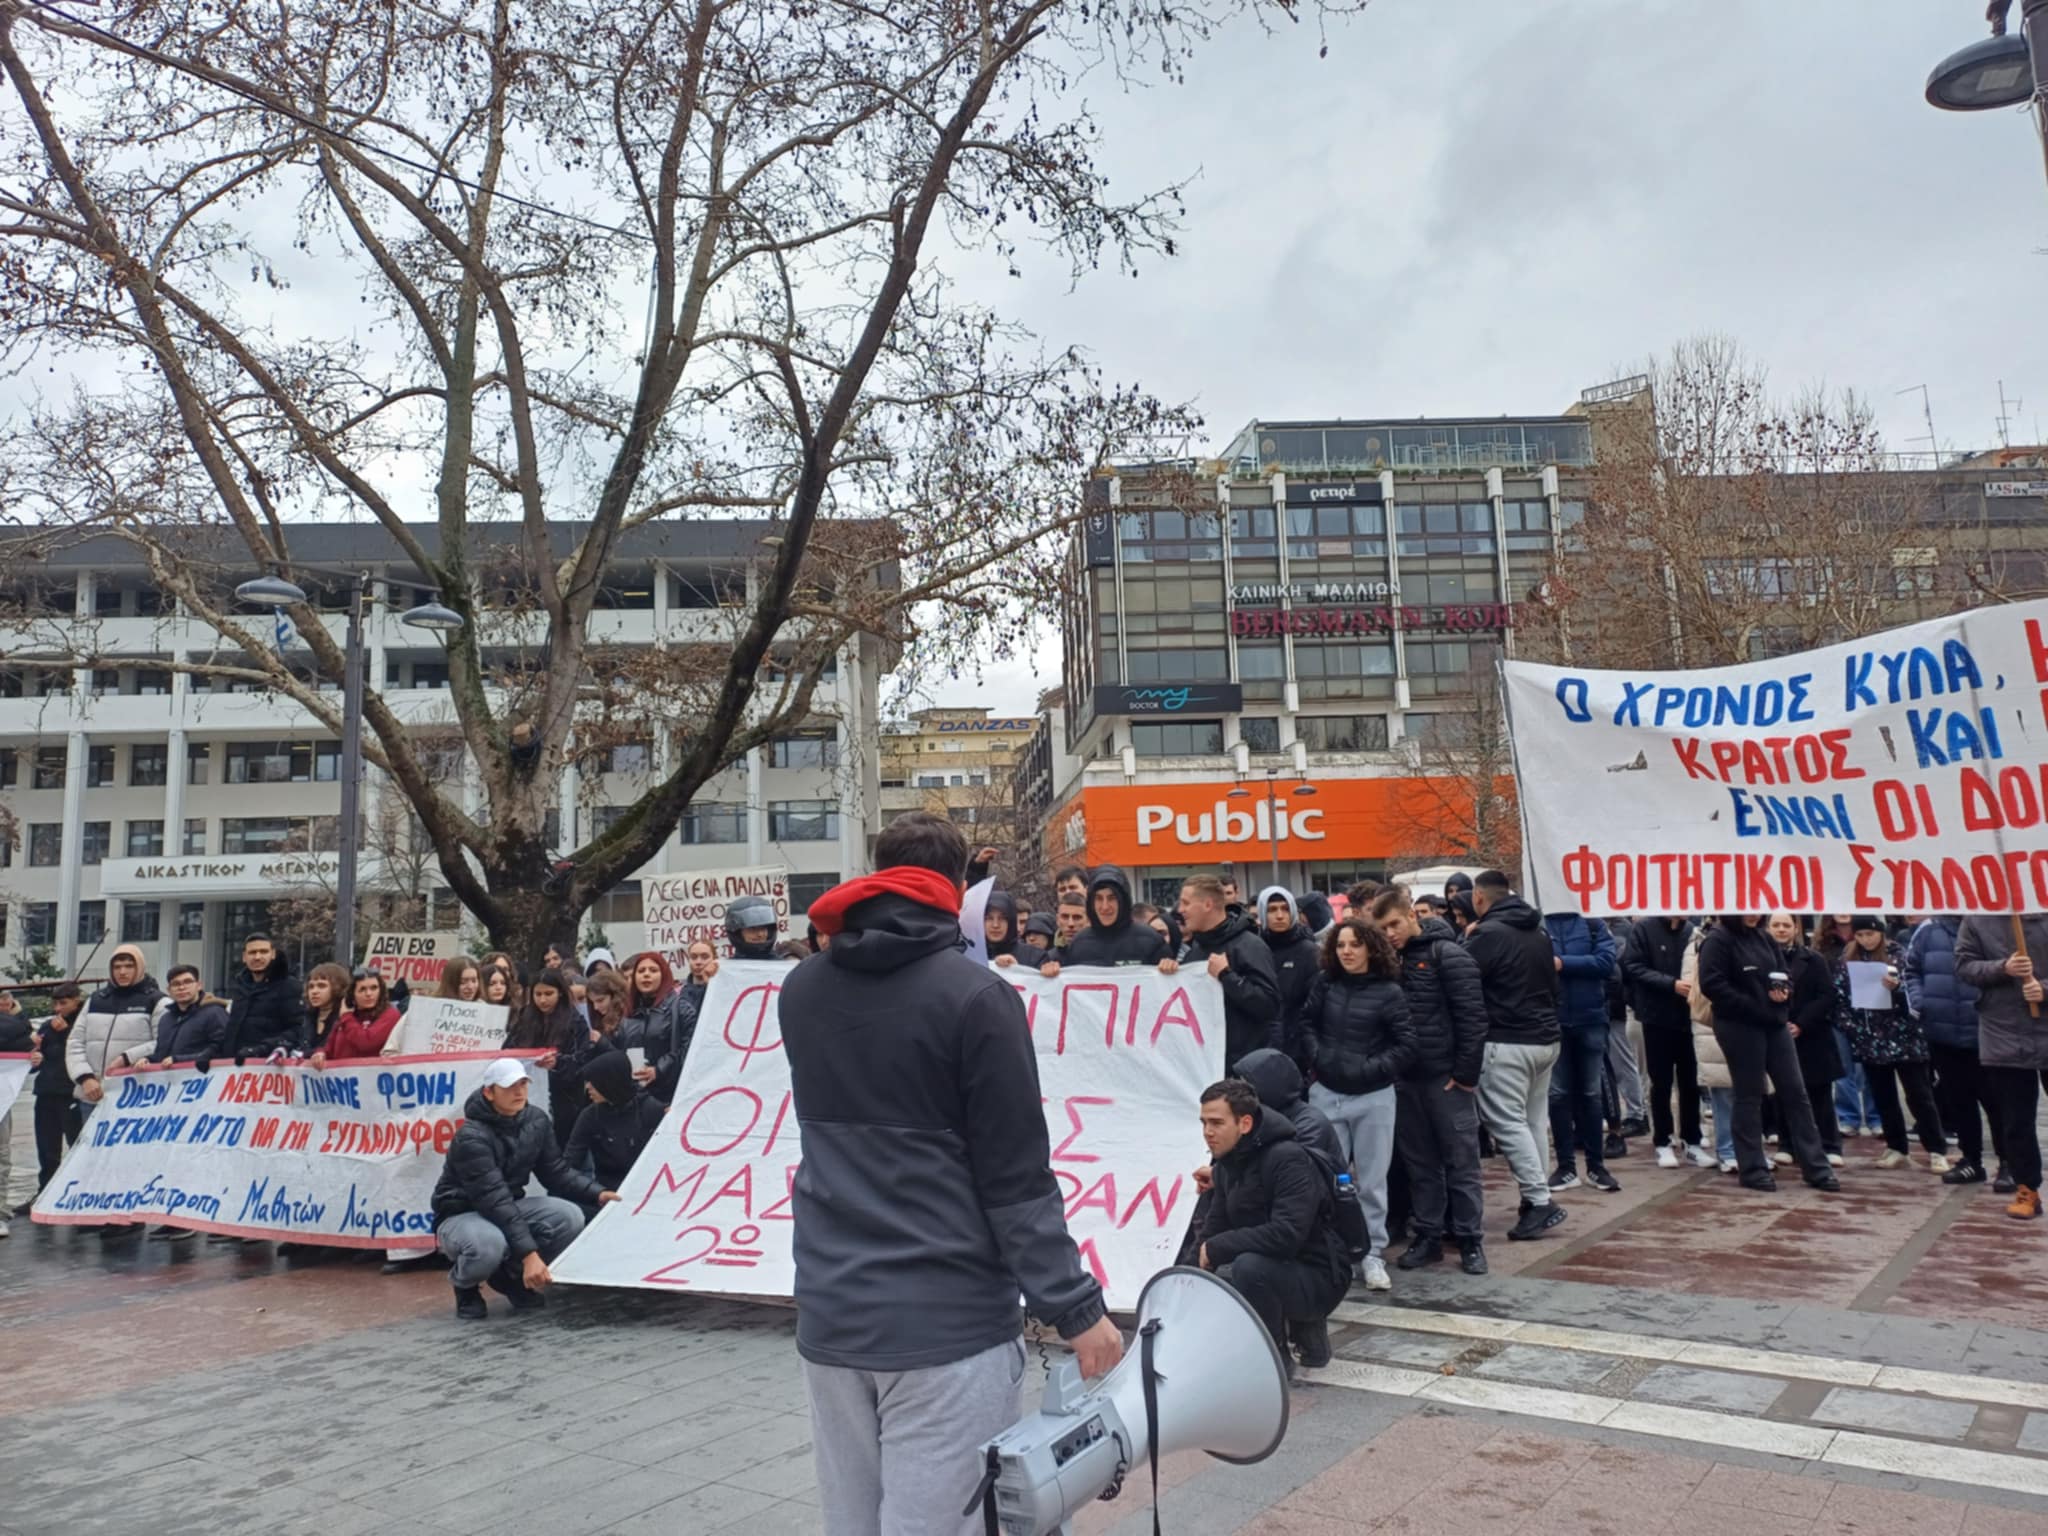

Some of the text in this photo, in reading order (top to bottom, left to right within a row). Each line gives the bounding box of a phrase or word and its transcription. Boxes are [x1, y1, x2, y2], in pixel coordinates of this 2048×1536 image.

[1310, 484, 1356, 500] ρετιρέ
[1228, 582, 1400, 598] ΚΛΙΝΙΚΗ ΜΑΛΛΙΩΝ
[1231, 605, 1423, 635] BERGMANN
[1129, 702, 1159, 710] DOCTOR
[1556, 677, 1593, 722] Ο
[1613, 673, 1815, 728] ΧΡΟΝΟΣ
[938, 720, 1031, 732] DANZAS
[1672, 729, 1867, 785] ΚΡΑΤΟΣ
[1906, 706, 2003, 769] ΚΑΙ
[1136, 799, 1326, 845] Public
[1727, 787, 1856, 840] ΕΙΝΑΙ
[1873, 779, 1940, 842] ΟΙ
[692, 878, 721, 899] ΕΝΑ
[725, 875, 771, 897] ΠΑΙΔΙ
[1562, 845, 1825, 913] ΦΟΙΤΗΤΙΚΟΙ
[646, 903, 680, 923] ΔΕΝ
[372, 936, 436, 956] ΔΕΝ ΕΧΩ
[649, 927, 676, 946] ΓΙΑ
[218, 1072, 295, 1105] ΝΕΚΡΩΝ
[301, 1074, 361, 1110] ΓΙΝΑΜΕ
[377, 1070, 456, 1110] ΦΩΝΗ
[188, 1113, 246, 1147] ΑΥΤΟ
[250, 1117, 280, 1149] ΝΑ
[279, 1119, 314, 1150] ΜΗ
[238, 1176, 326, 1226] Μαθητών
